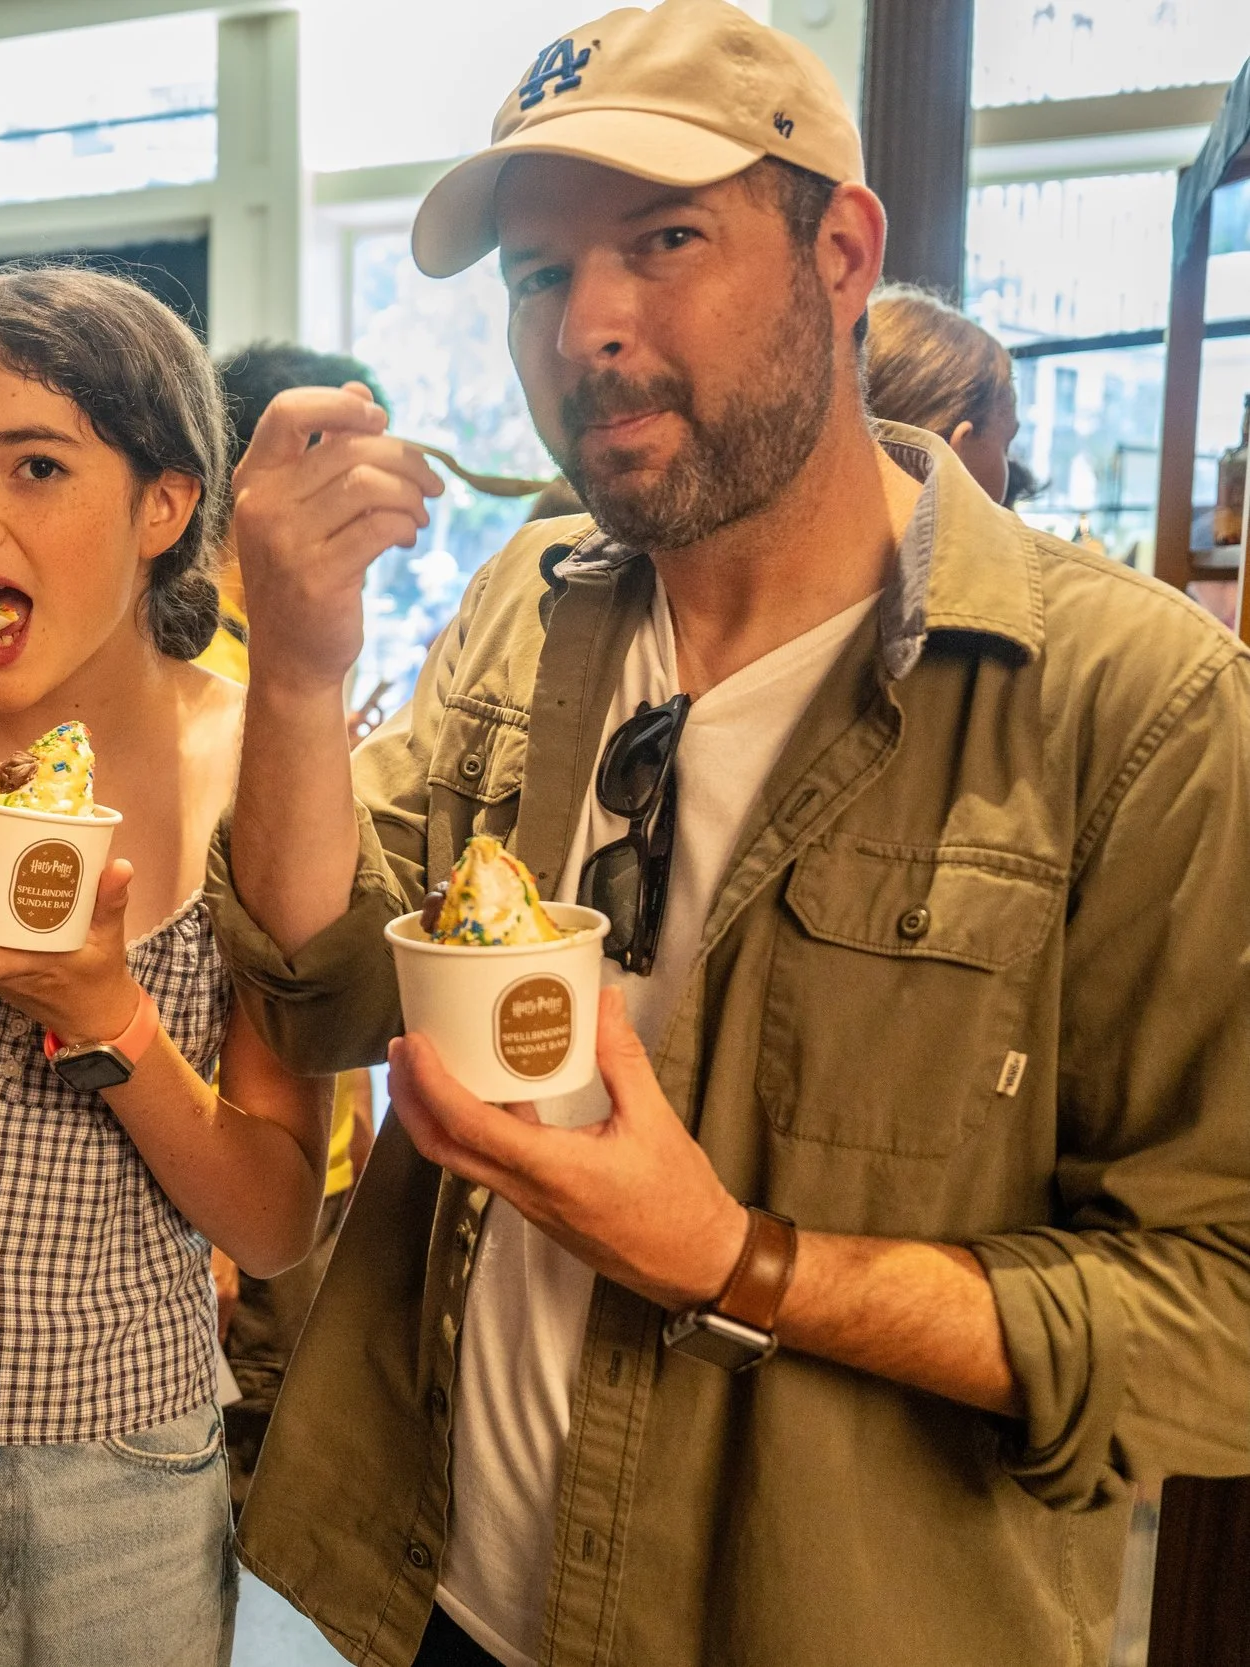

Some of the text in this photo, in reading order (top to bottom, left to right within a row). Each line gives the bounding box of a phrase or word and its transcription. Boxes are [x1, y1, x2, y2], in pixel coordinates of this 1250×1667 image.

[518, 38, 591, 111] LA
[30, 859, 73, 876] Harry Potter
[16, 885, 74, 898] SPELLBINDING
[16, 897, 70, 910] SUNDAE BAR
[501, 1024, 570, 1042] SPELLBINDING
[504, 1041, 547, 1056] SUNDAE
